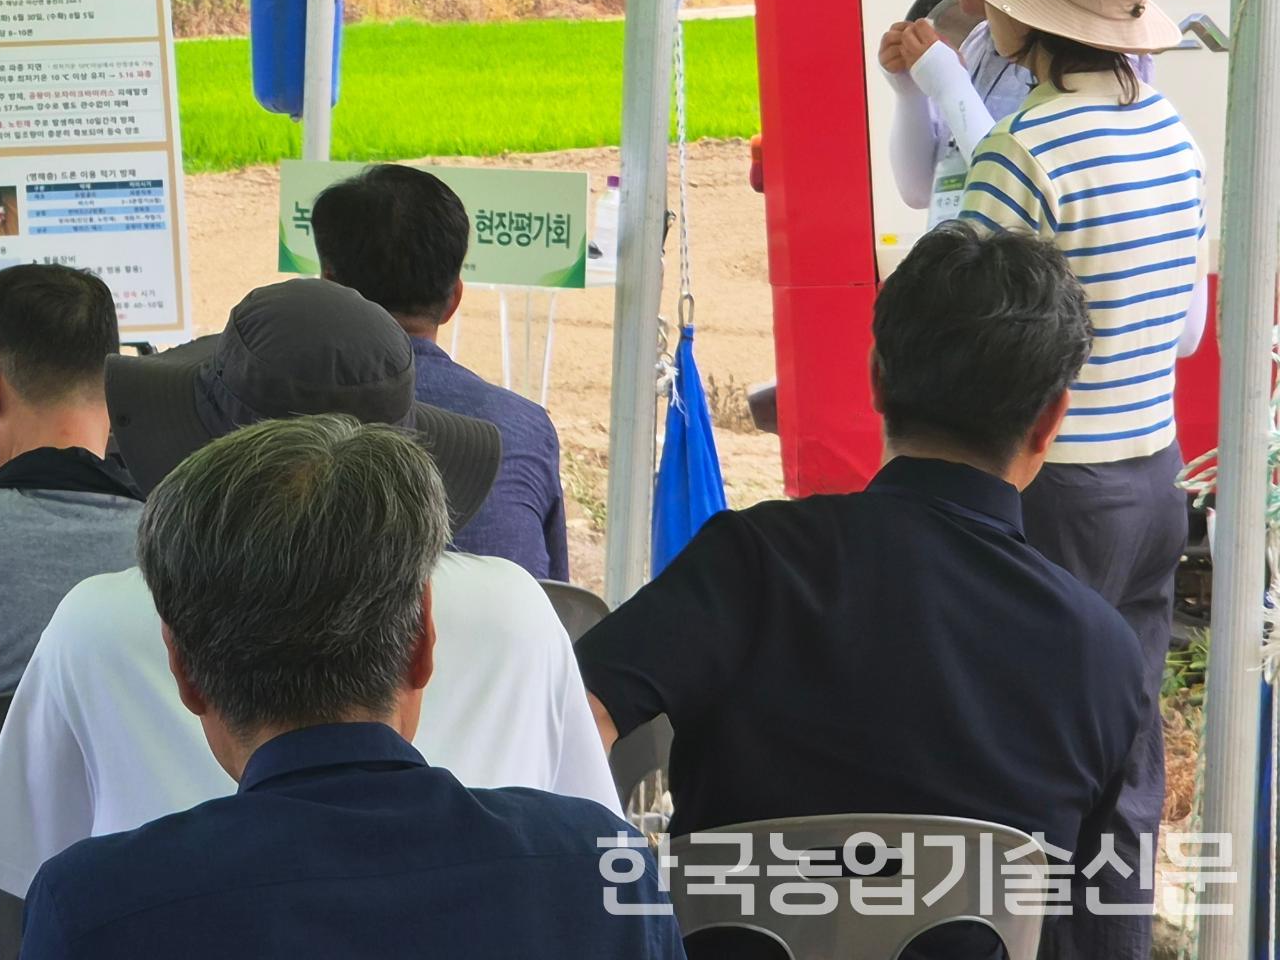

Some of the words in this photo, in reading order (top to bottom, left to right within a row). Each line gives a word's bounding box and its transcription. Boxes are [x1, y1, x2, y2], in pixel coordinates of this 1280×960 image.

[83, 11, 94, 19] 5일
[9, 64, 23, 72] 파종
[27, 63, 42, 71] 지연
[73, 72, 87, 80] 이상
[137, 70, 151, 78] 파종
[118, 88, 148, 96] 피해발생
[37, 102, 59, 110] 강수로
[62, 101, 77, 109] 별도
[86, 117, 117, 125] 10일간격
[120, 116, 135, 124] 방제
[61, 171, 77, 179] 드론
[80, 170, 96, 179] 이용
[100, 169, 116, 178] 적기
[120, 168, 136, 177] 방제
[475, 209, 570, 249] 현장평가회
